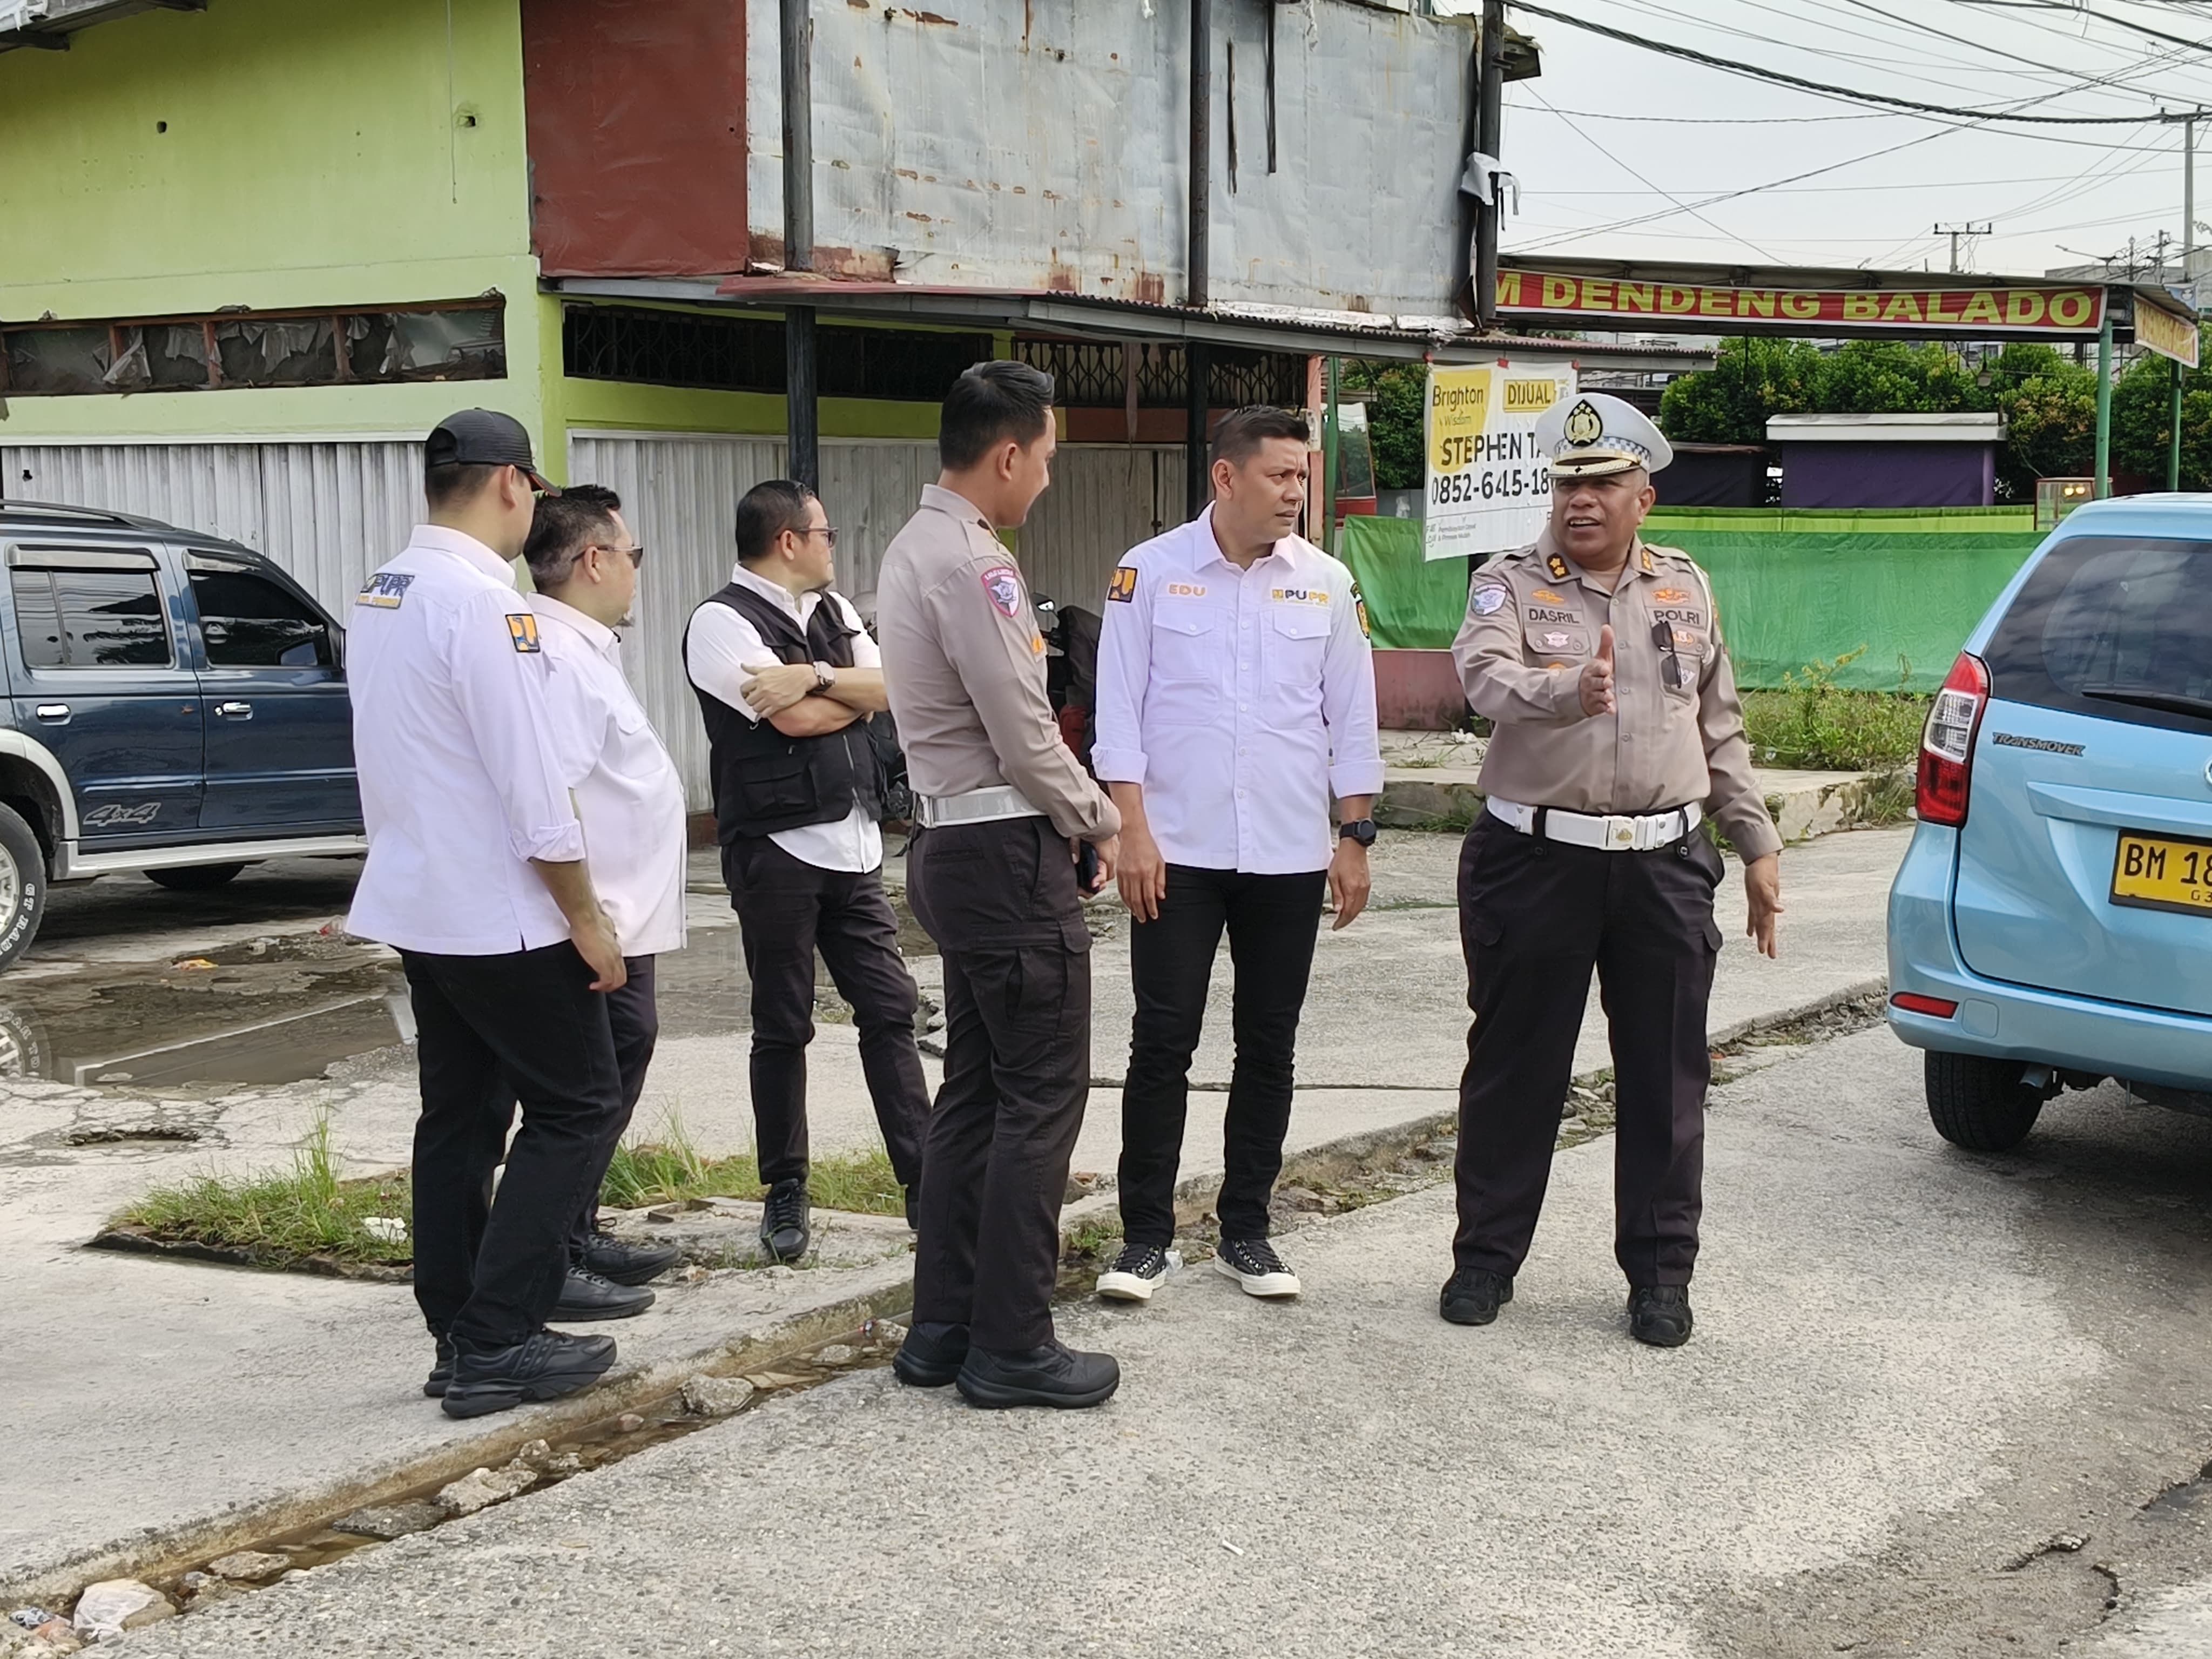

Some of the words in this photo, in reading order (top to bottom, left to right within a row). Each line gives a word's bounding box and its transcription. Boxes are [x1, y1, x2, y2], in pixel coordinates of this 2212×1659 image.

[1542, 275, 1820, 318] DENDENG
[1843, 291, 2093, 326] BALADO
[1433, 385, 1483, 412] Brighton
[1508, 382, 1551, 405] DIJUAL
[1441, 433, 1522, 466] STEPHEN
[1168, 584, 1206, 596] EDU
[1285, 589, 1328, 603] PUPR
[1528, 608, 1580, 624] DASRIL
[1654, 610, 1700, 625] POLRI
[1993, 732, 2086, 757] TRANSMOVER
[83, 802, 161, 826] 4x4
[2125, 843, 2166, 880] BM
